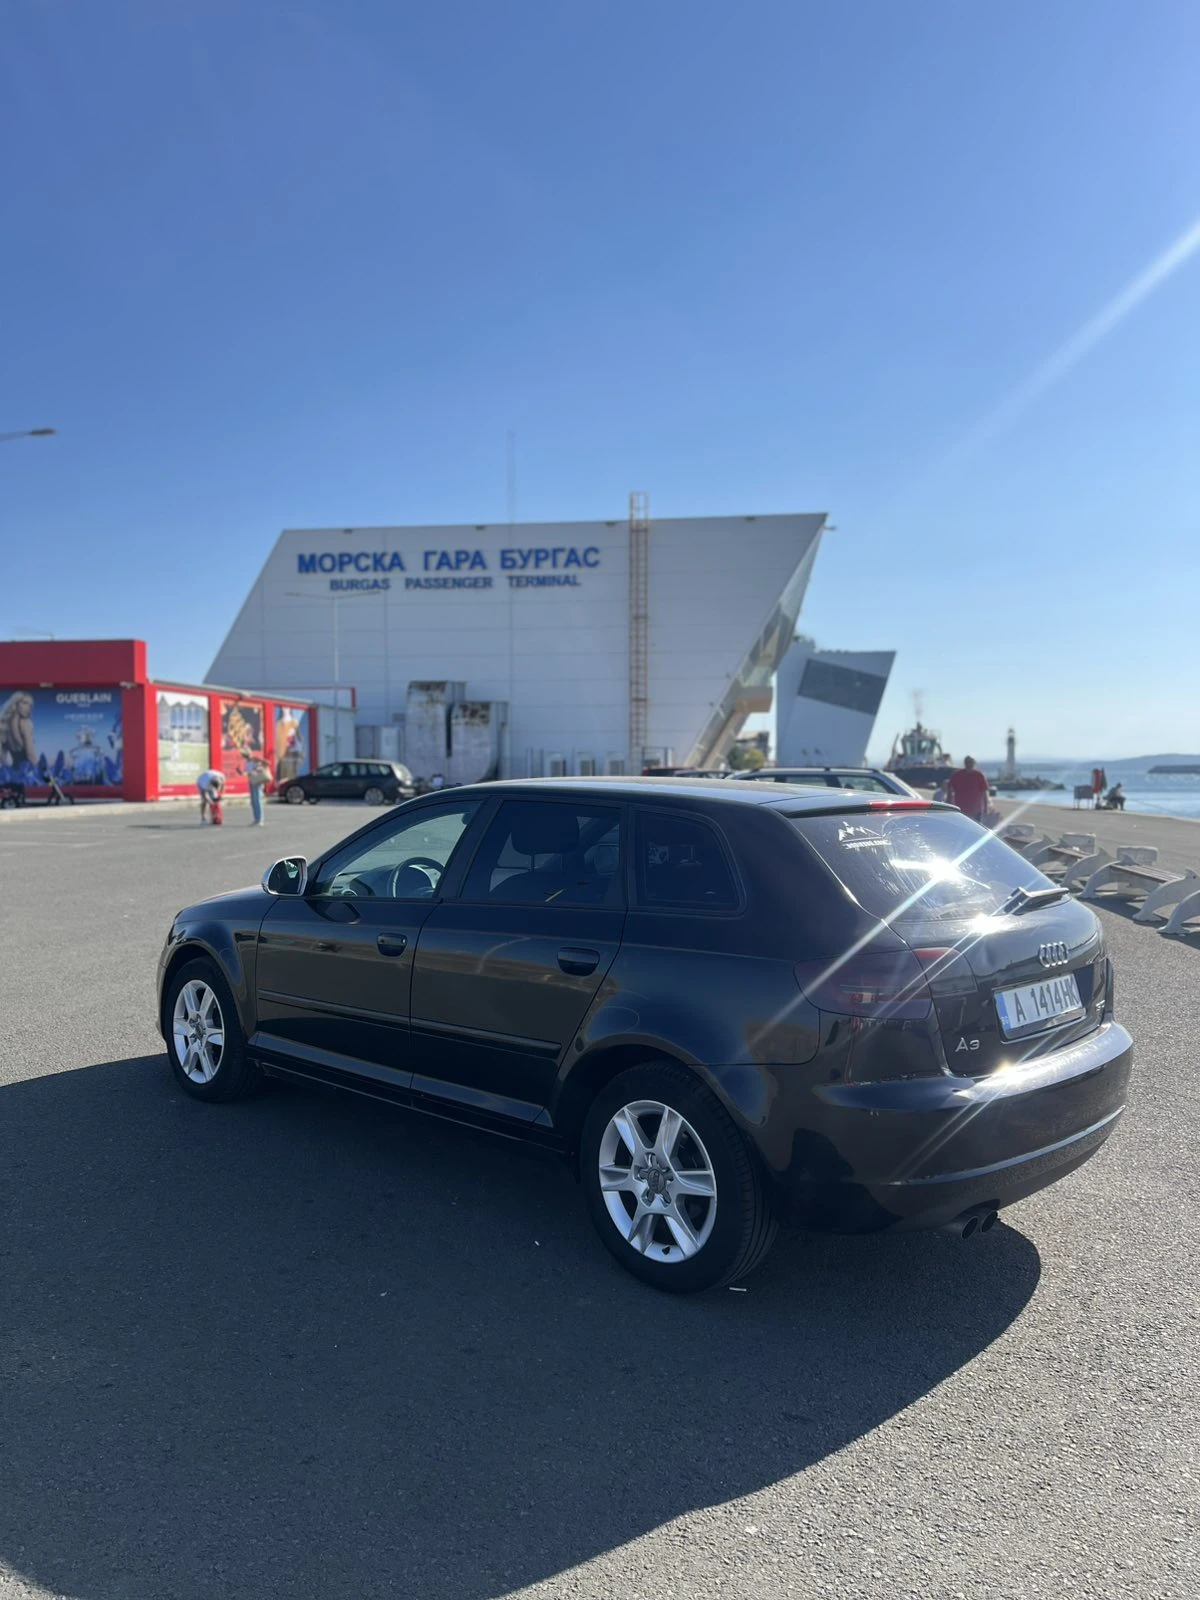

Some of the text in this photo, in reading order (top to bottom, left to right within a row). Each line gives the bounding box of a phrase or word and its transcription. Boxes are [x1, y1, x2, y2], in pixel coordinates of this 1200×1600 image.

[298, 546, 600, 573] МОРСКА ГАРА БУРГАС
[330, 574, 581, 591] BURGAS PASSENGER TERMINAL
[955, 1037, 980, 1052] A3
